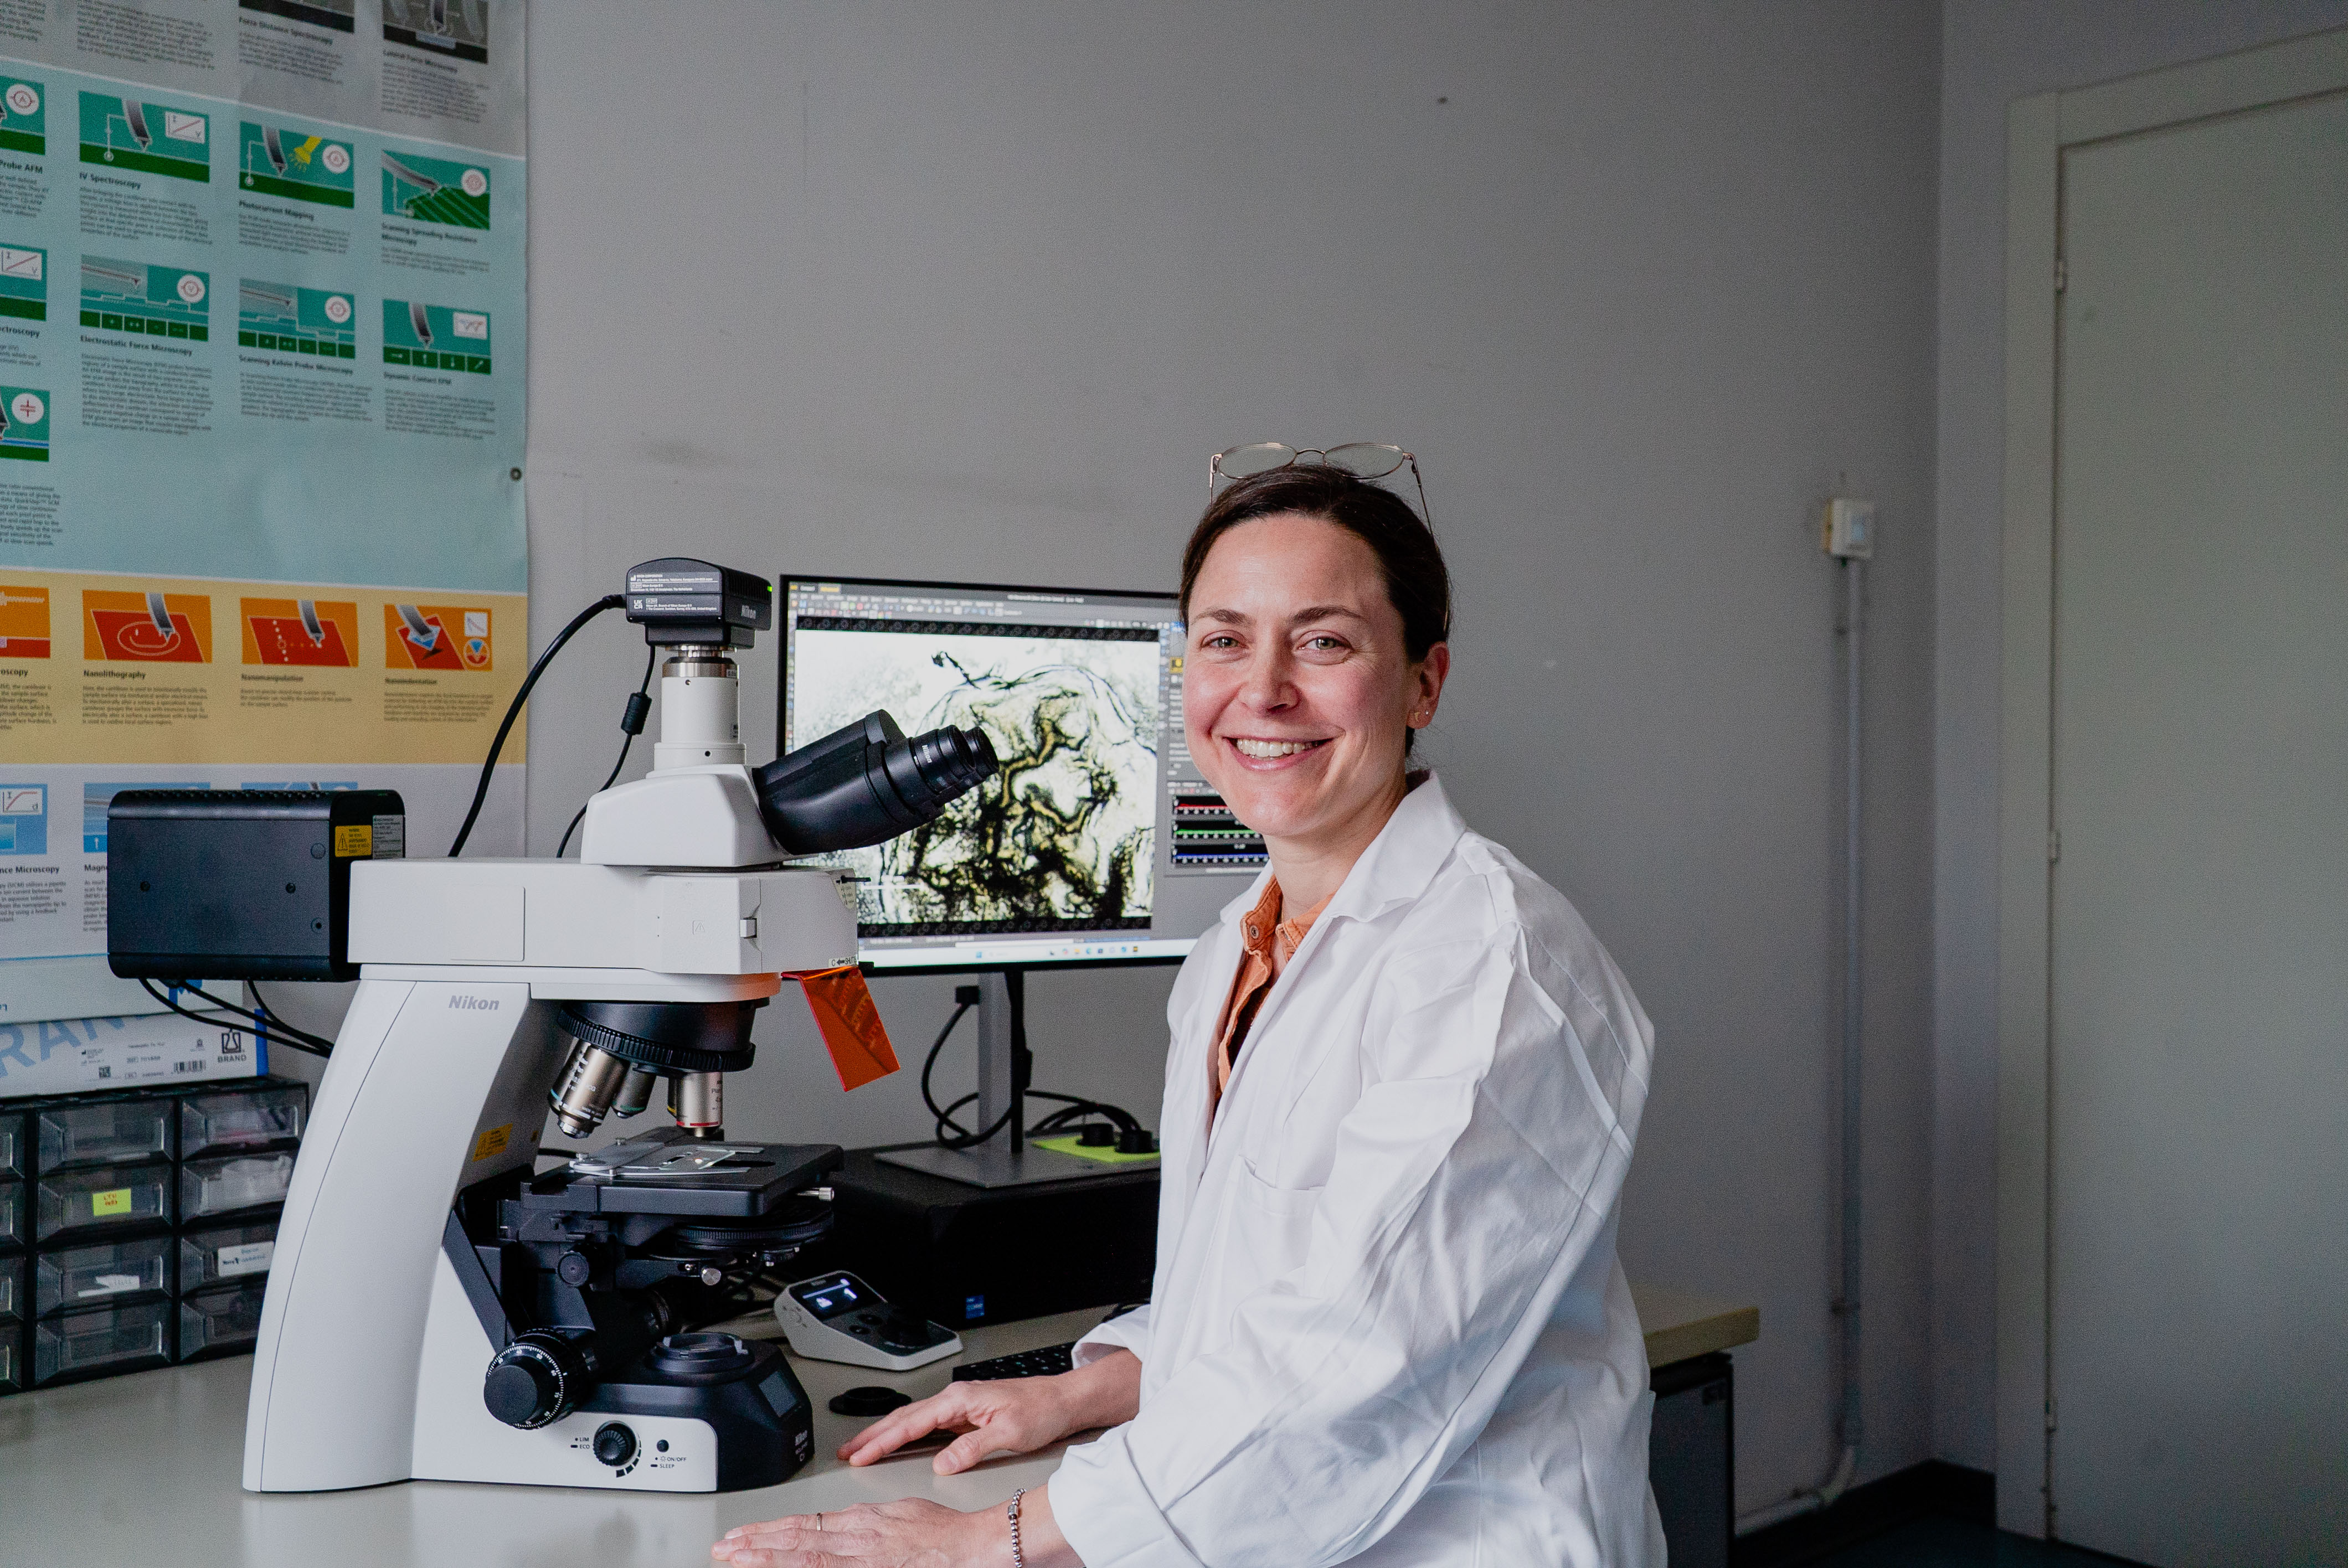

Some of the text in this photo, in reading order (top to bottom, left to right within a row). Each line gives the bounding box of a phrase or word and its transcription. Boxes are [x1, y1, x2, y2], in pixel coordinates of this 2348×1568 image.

[24, 164, 43, 174] AFM
[91, 174, 141, 190] Spectroscopy
[239, 200, 314, 221] Photocurrent Mapping
[382, 223, 410, 235] Scanning
[382, 233, 418, 246] Microscopy
[80, 335, 192, 357] Electrostatic Force Microscopy
[239, 354, 353, 375] Scanning Kelvin Probe Microscopy
[384, 371, 410, 381] Dynamic
[413, 374, 436, 384] Contact
[741, 605, 756, 620] Nikon
[0, 669, 28, 678] oscopy
[83, 670, 146, 679] Nanolithography
[241, 673, 303, 684] Nanomanipulation
[385, 677, 437, 686] Nanoindentation
[922, 745, 932, 763] Nikon
[16, 866, 59, 874] Microscopy
[84, 864, 107, 873] Magn
[449, 995, 500, 1010] Nikon
[217, 1054, 247, 1063] BRAND
